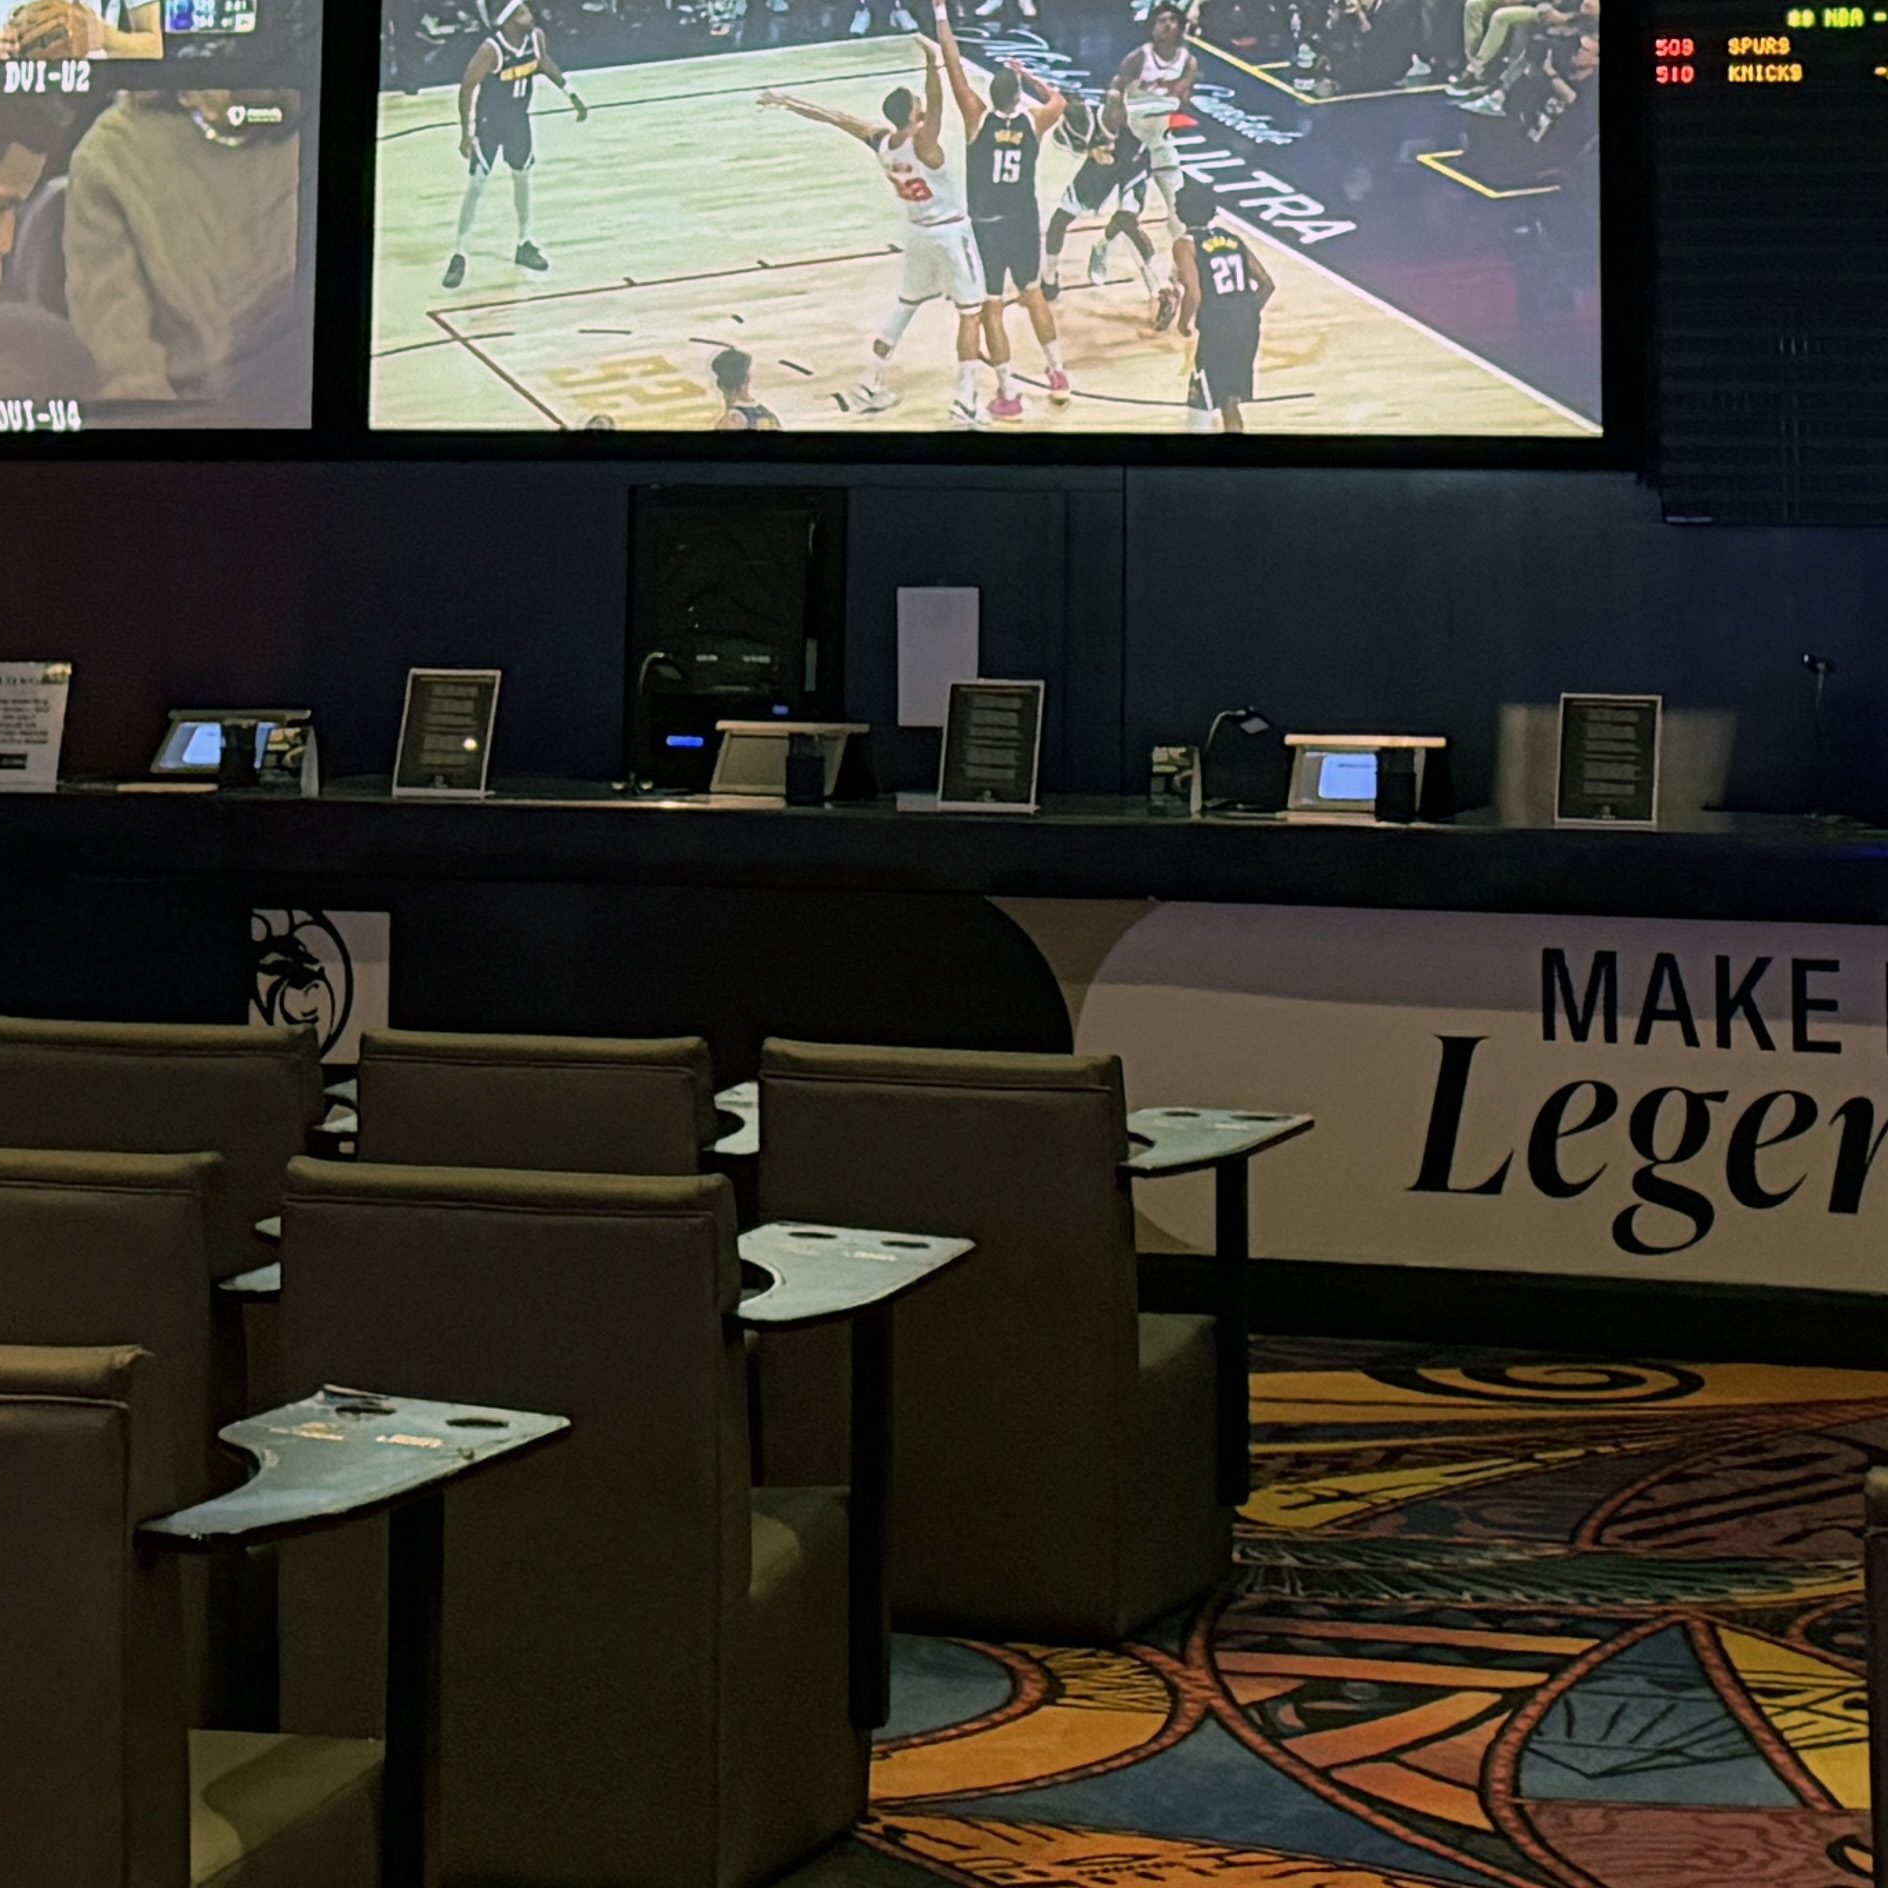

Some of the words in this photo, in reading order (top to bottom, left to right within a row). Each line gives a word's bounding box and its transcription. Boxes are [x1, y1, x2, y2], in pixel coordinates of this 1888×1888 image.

[1823, 7, 1864, 28] NBA
[1728, 36, 1790, 55] SPURS
[4, 62, 90, 93] DVI-U2
[1728, 64, 1802, 82] KNICKS
[993, 149, 1021, 182] 15
[1172, 134, 1357, 245] ULTRA
[1209, 255, 1244, 294] 27
[1542, 947, 1841, 1054] MAKE
